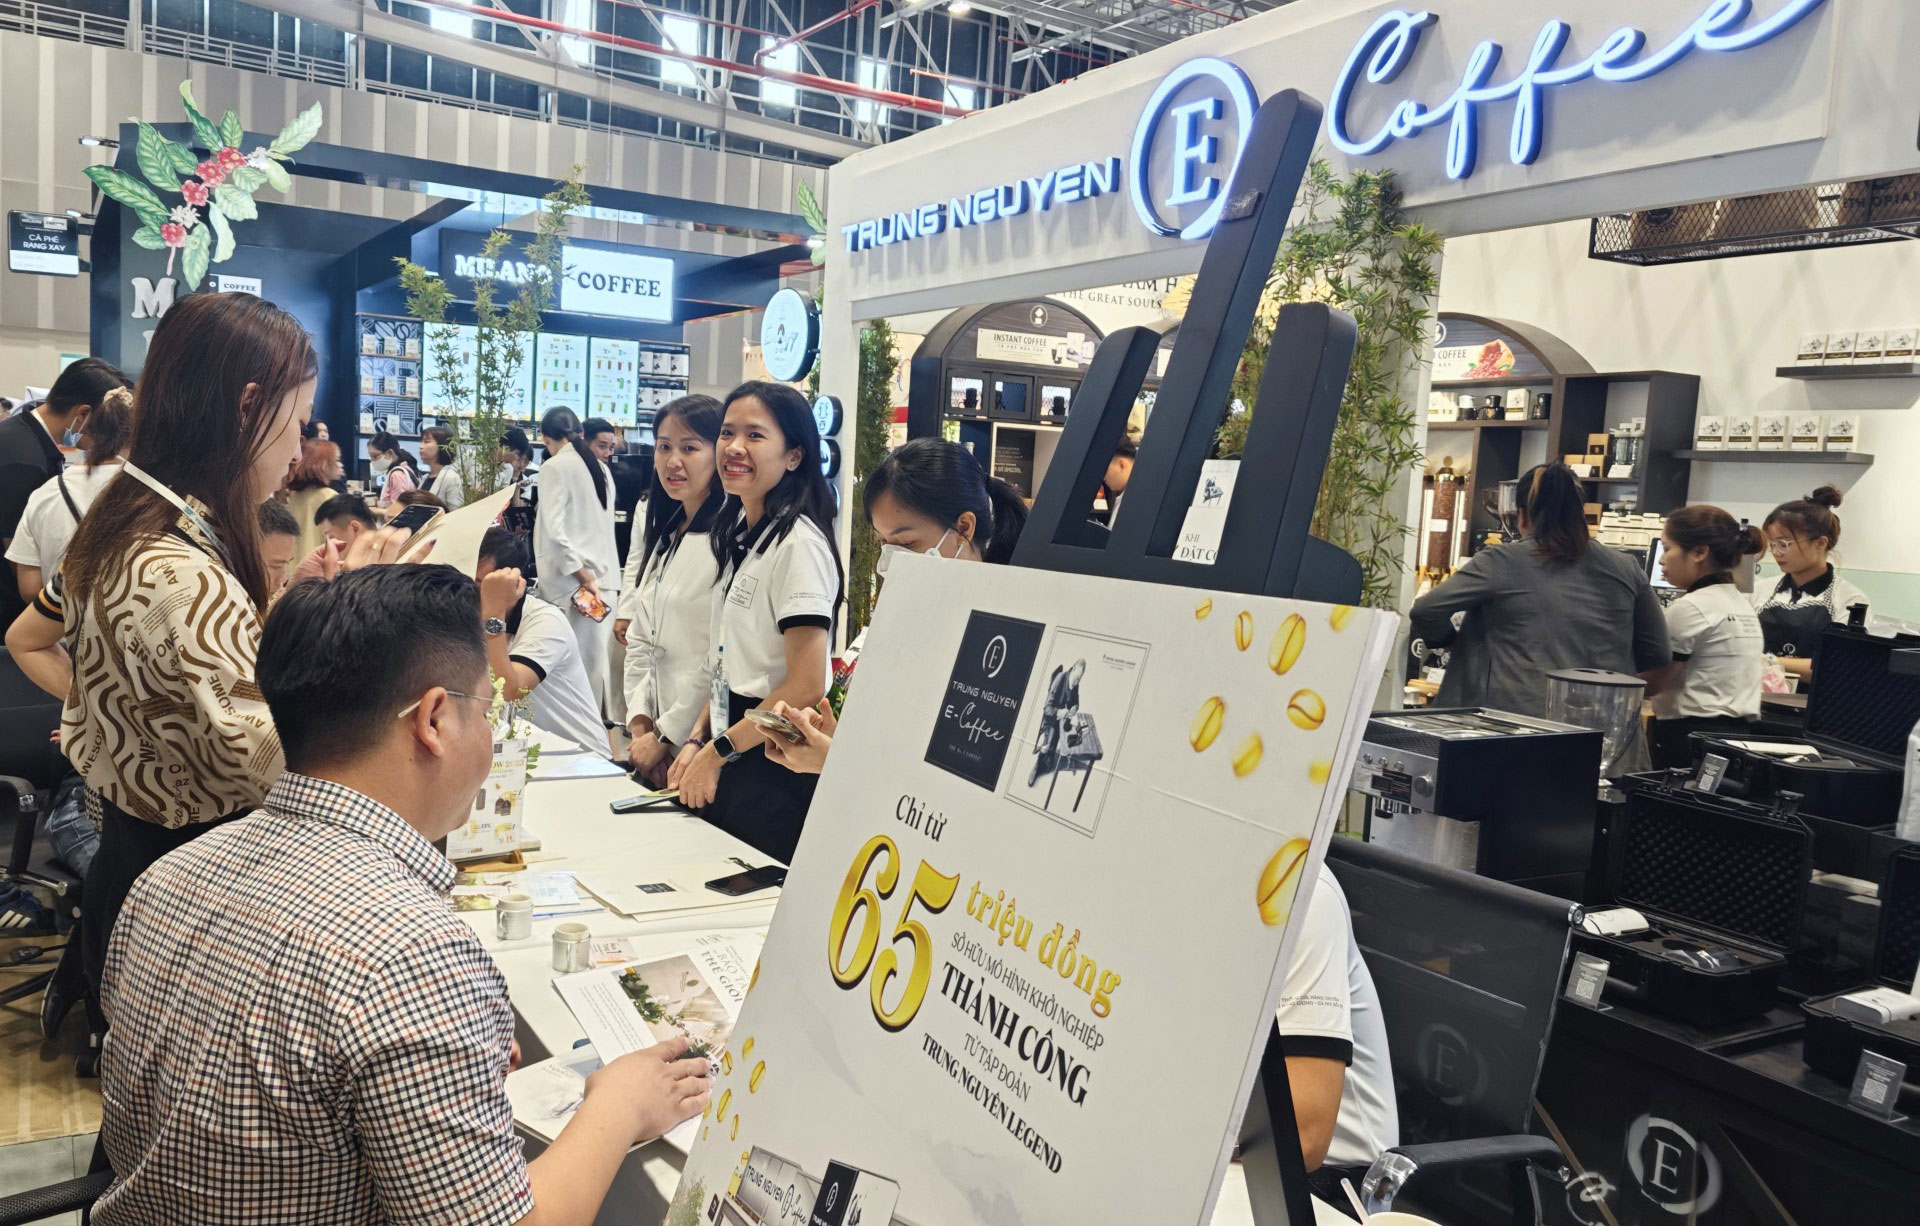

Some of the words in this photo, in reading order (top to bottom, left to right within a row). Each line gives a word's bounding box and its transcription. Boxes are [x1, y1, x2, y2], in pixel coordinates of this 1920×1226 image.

[841, 204, 946, 252] TRUNG
[948, 157, 1122, 228] NGUYEN
[1164, 97, 1220, 206] E
[1327, 0, 1826, 179] Coffee
[23, 241, 47, 250] RANG
[223, 282, 257, 292] COFFEE
[577, 272, 661, 297] COFFEE
[1088, 291, 1124, 304] GREAT
[1127, 297, 1162, 309] SOULS
[993, 333, 1022, 343] INSTANT
[1023, 336, 1047, 347] COFFEE
[1437, 349, 1467, 360] COFFEE
[156, 627, 179, 657] ONE
[207, 673, 266, 729] AWSOME
[952, 681, 980, 697] TRUNG
[980, 690, 1018, 709] NGUYEN
[896, 794, 924, 830] Chỉ
[924, 813, 948, 843] từ
[828, 834, 960, 1034] 65
[966, 880, 1034, 952] triệu
[1037, 922, 1122, 1019] đồng
[951, 931, 967, 952] SỞ
[964, 941, 988, 967] HỮU
[985, 956, 1003, 980] MÔ
[1001, 968, 1031, 1000] HÌNH
[1028, 986, 1060, 1021] KHỞI
[1056, 1007, 1104, 1052] NGHIỆP
[941, 961, 1021, 1049] THÀNH
[1018, 1025, 1092, 1108] CÔNG
[964, 1032, 981, 1056] TỪ
[979, 1044, 1000, 1073] TẬP
[997, 1062, 1031, 1103] ĐOÀN
[922, 1032, 960, 1080] TRUNG
[957, 1066, 1009, 1125] NGUYÊN
[1006, 1111, 1062, 1174] LEGEND
[745, 1165, 764, 1187] TRUNG
[761, 1177, 784, 1203] NGUYEN
[1649, 1137, 1683, 1195] E
